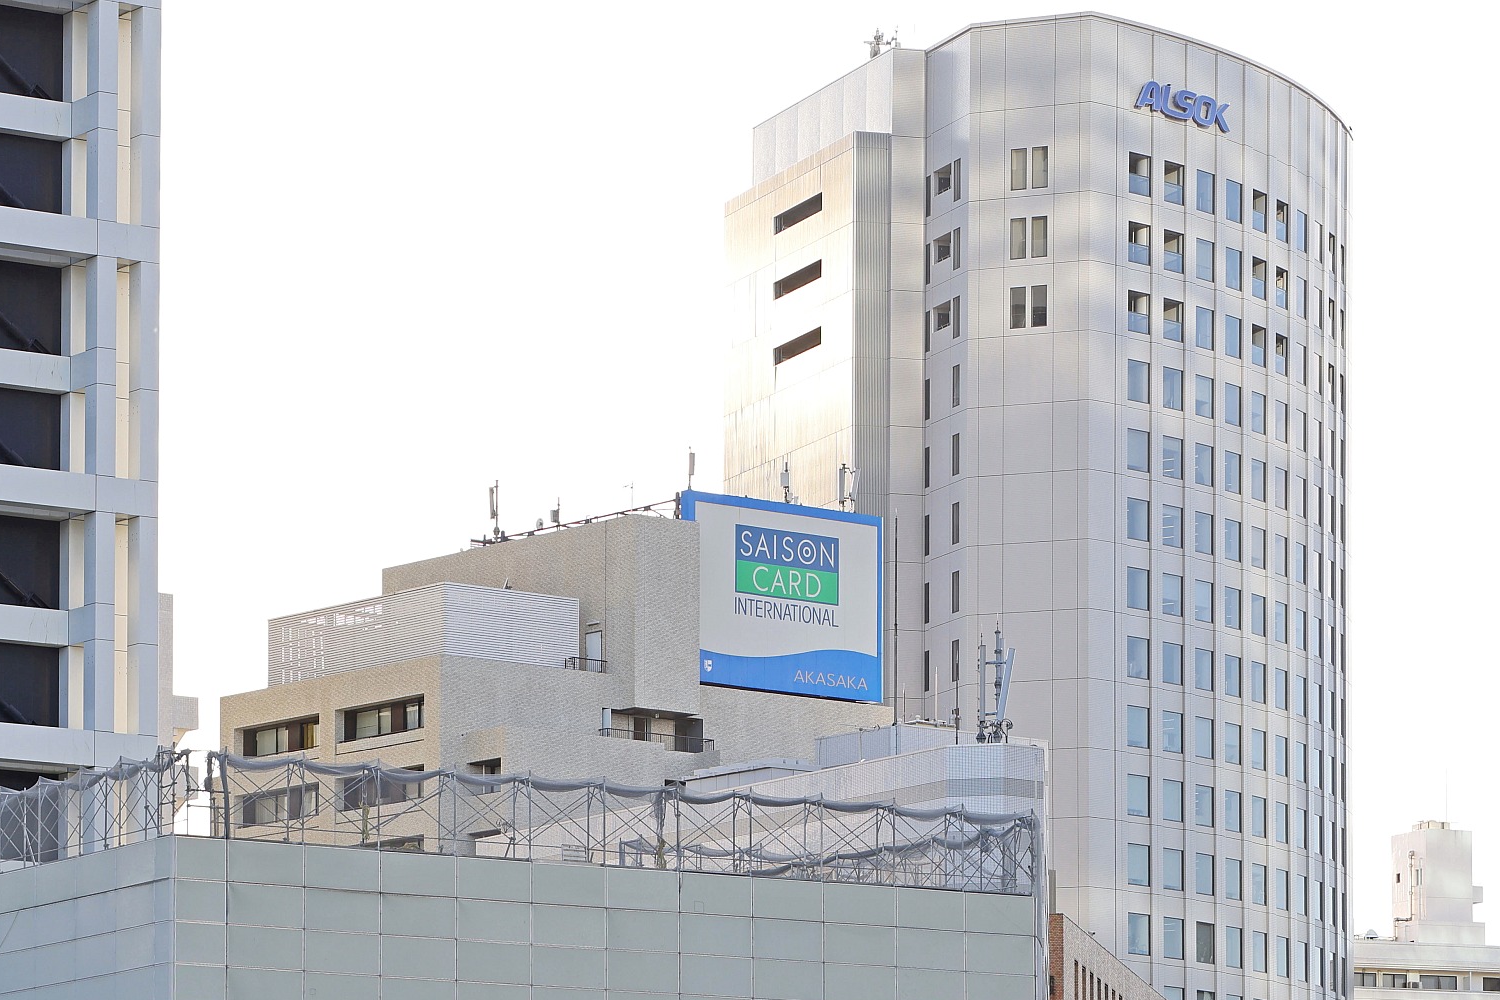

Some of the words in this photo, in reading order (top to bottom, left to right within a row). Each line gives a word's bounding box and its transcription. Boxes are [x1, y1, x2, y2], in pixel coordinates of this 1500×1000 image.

[1134, 80, 1230, 133] ALSOK
[740, 530, 835, 568] SAISON
[752, 565, 822, 598] CARD
[734, 596, 840, 628] INTERNATIONAL
[793, 669, 869, 691] AKASAKA
